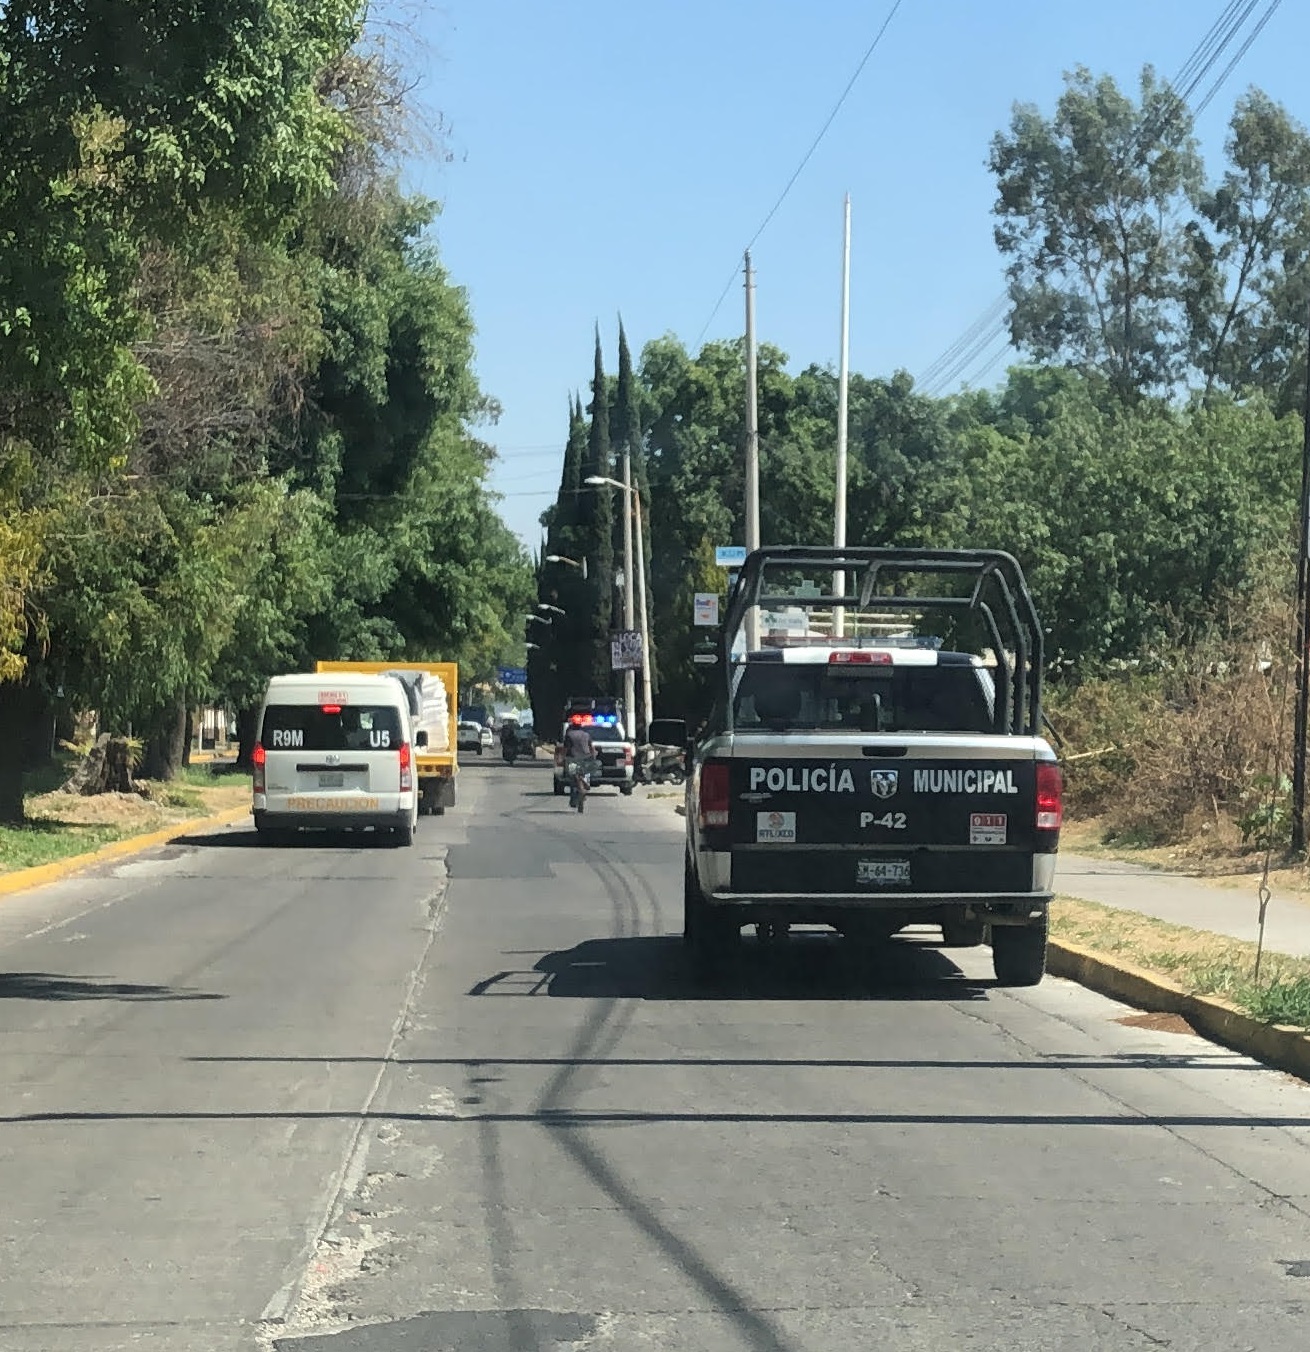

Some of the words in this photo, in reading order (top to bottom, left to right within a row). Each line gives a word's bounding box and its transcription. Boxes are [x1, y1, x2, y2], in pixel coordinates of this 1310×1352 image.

[272, 729, 304, 747] R9M
[369, 730, 391, 748] U5
[750, 762, 855, 793] POLICÍA
[913, 768, 1018, 794] MUNICIPAL
[860, 811, 907, 829] P-42
